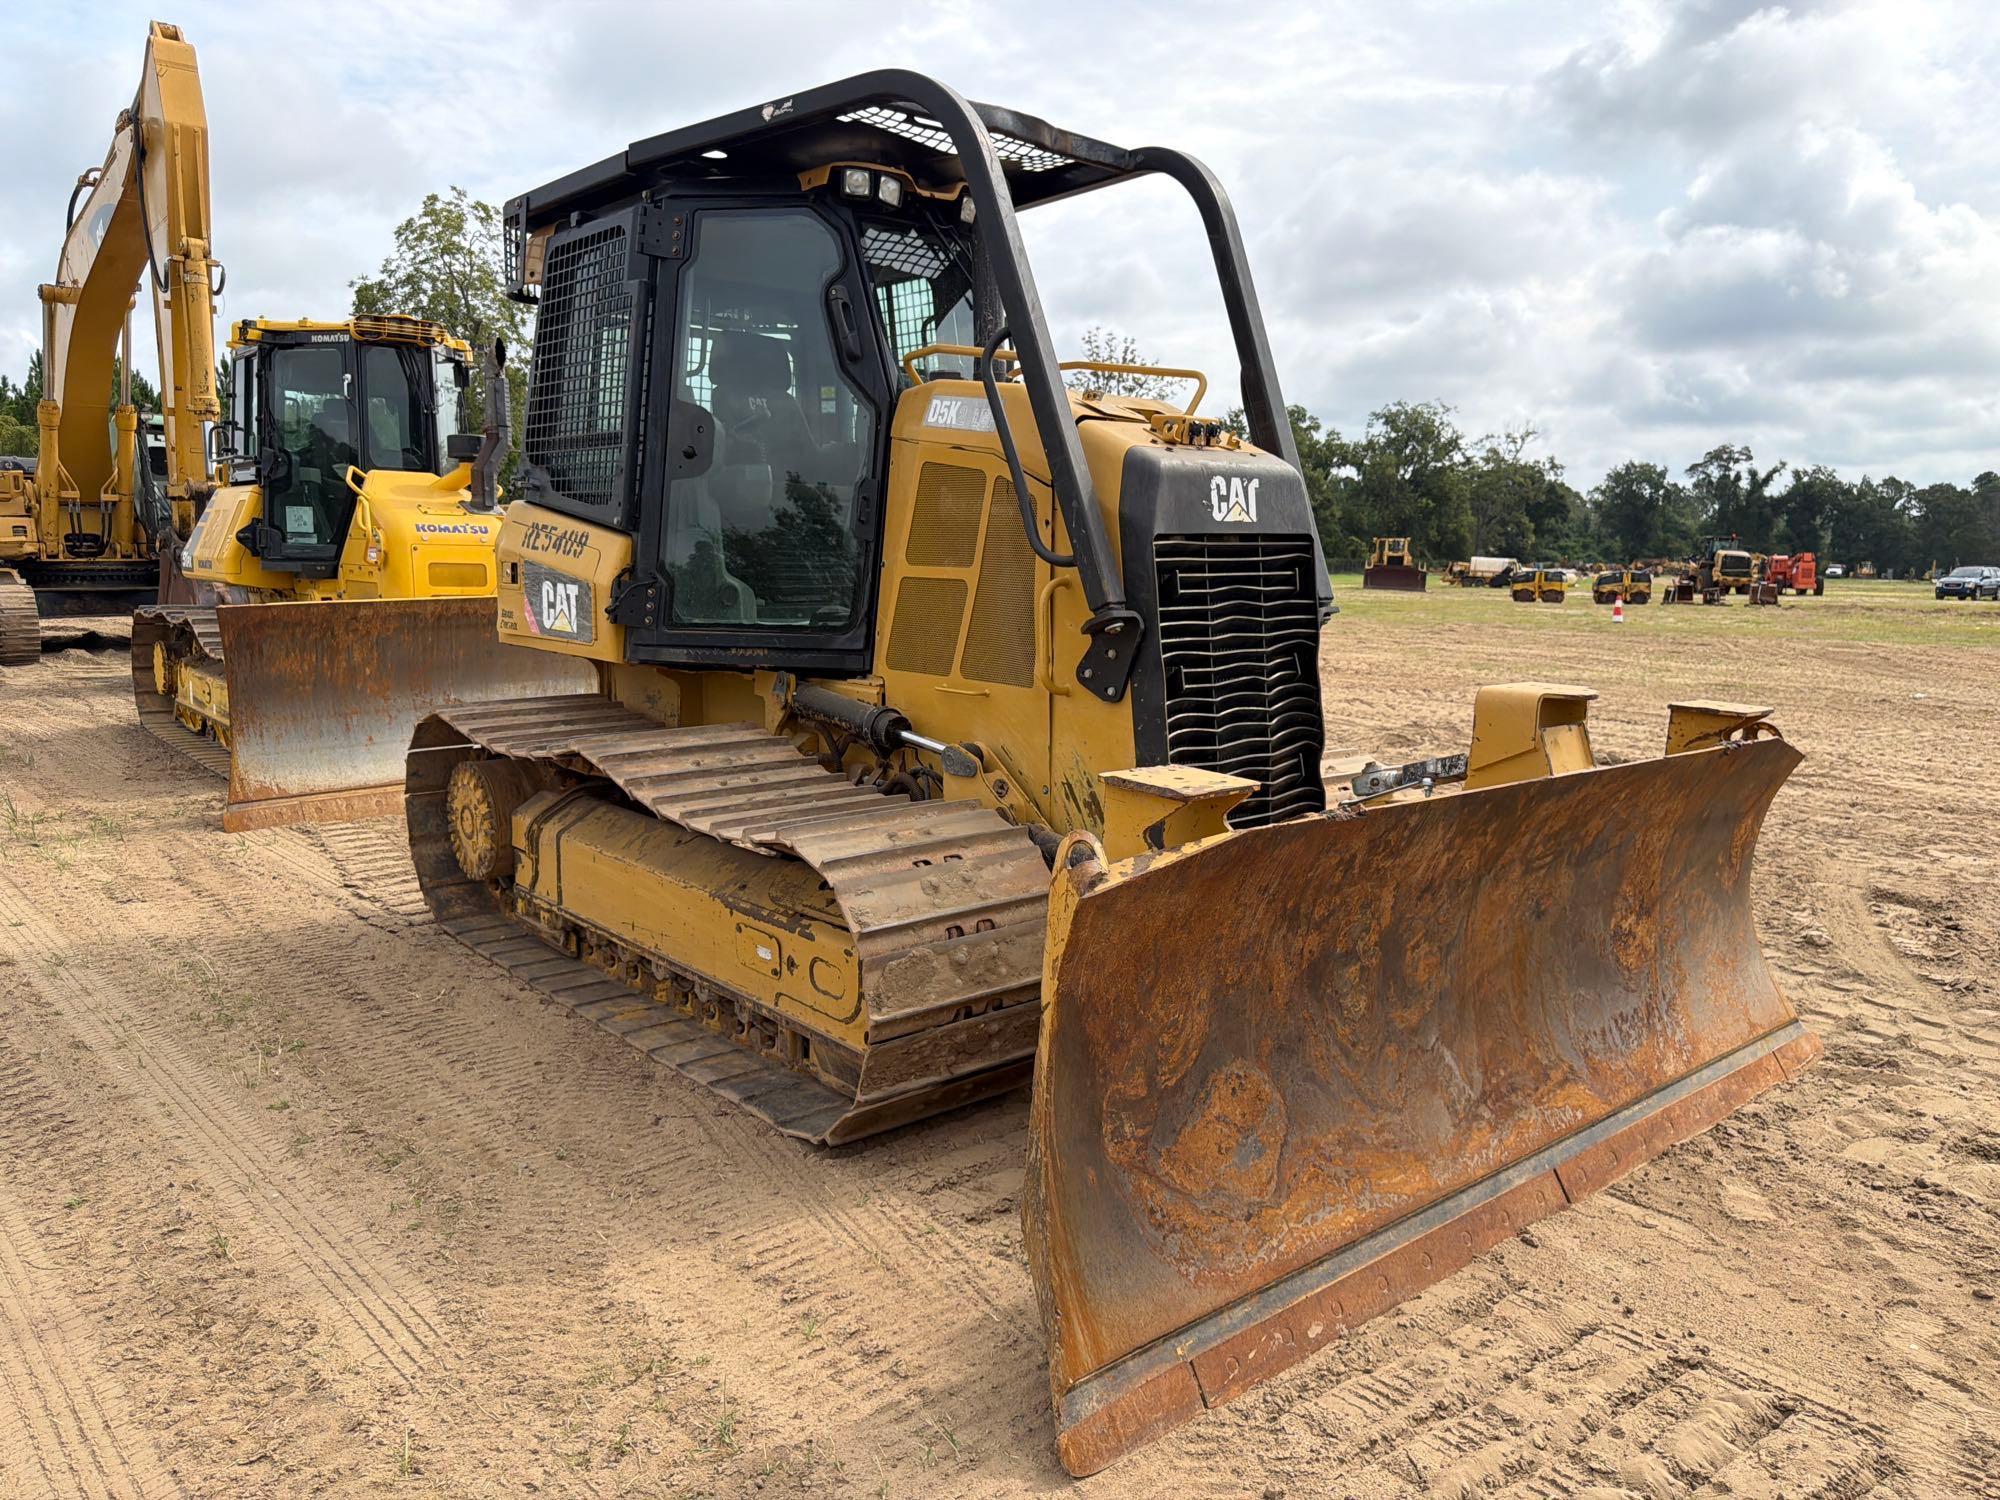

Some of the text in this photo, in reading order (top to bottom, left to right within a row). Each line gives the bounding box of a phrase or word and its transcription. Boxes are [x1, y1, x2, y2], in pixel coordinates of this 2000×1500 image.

[311, 333, 350, 343] KOMATSU
[1210, 475, 1259, 523] CAT
[415, 523, 489, 535] KOMATSU
[542, 580, 579, 633] CAT
